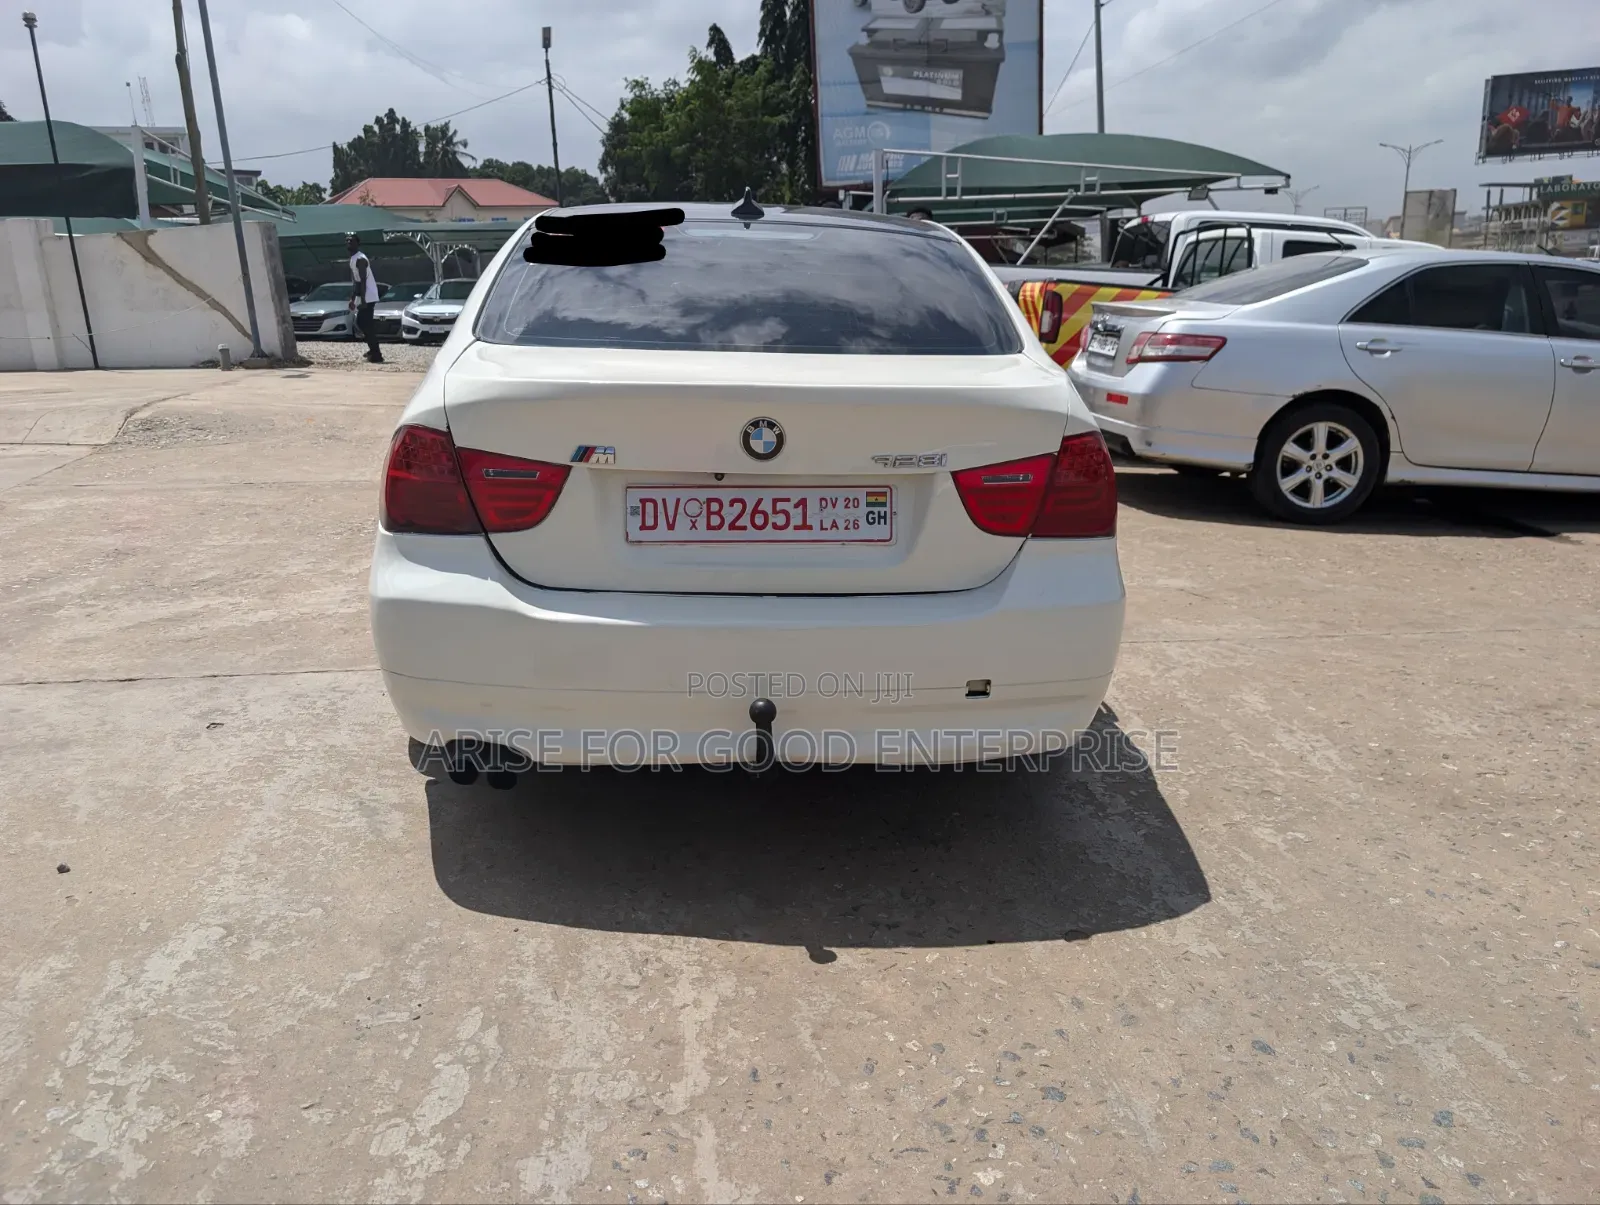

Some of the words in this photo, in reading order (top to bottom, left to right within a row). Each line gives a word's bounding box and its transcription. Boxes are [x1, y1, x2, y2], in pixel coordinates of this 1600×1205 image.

[913, 71, 960, 80] PLATINUM
[833, 126, 866, 140] AGM
[819, 497, 839, 510] DV
[844, 496, 861, 509] 20
[639, 497, 681, 531] DV
[705, 497, 813, 531] B2651
[865, 510, 888, 526] GH
[820, 519, 840, 532] LA
[844, 518, 861, 531] 26
